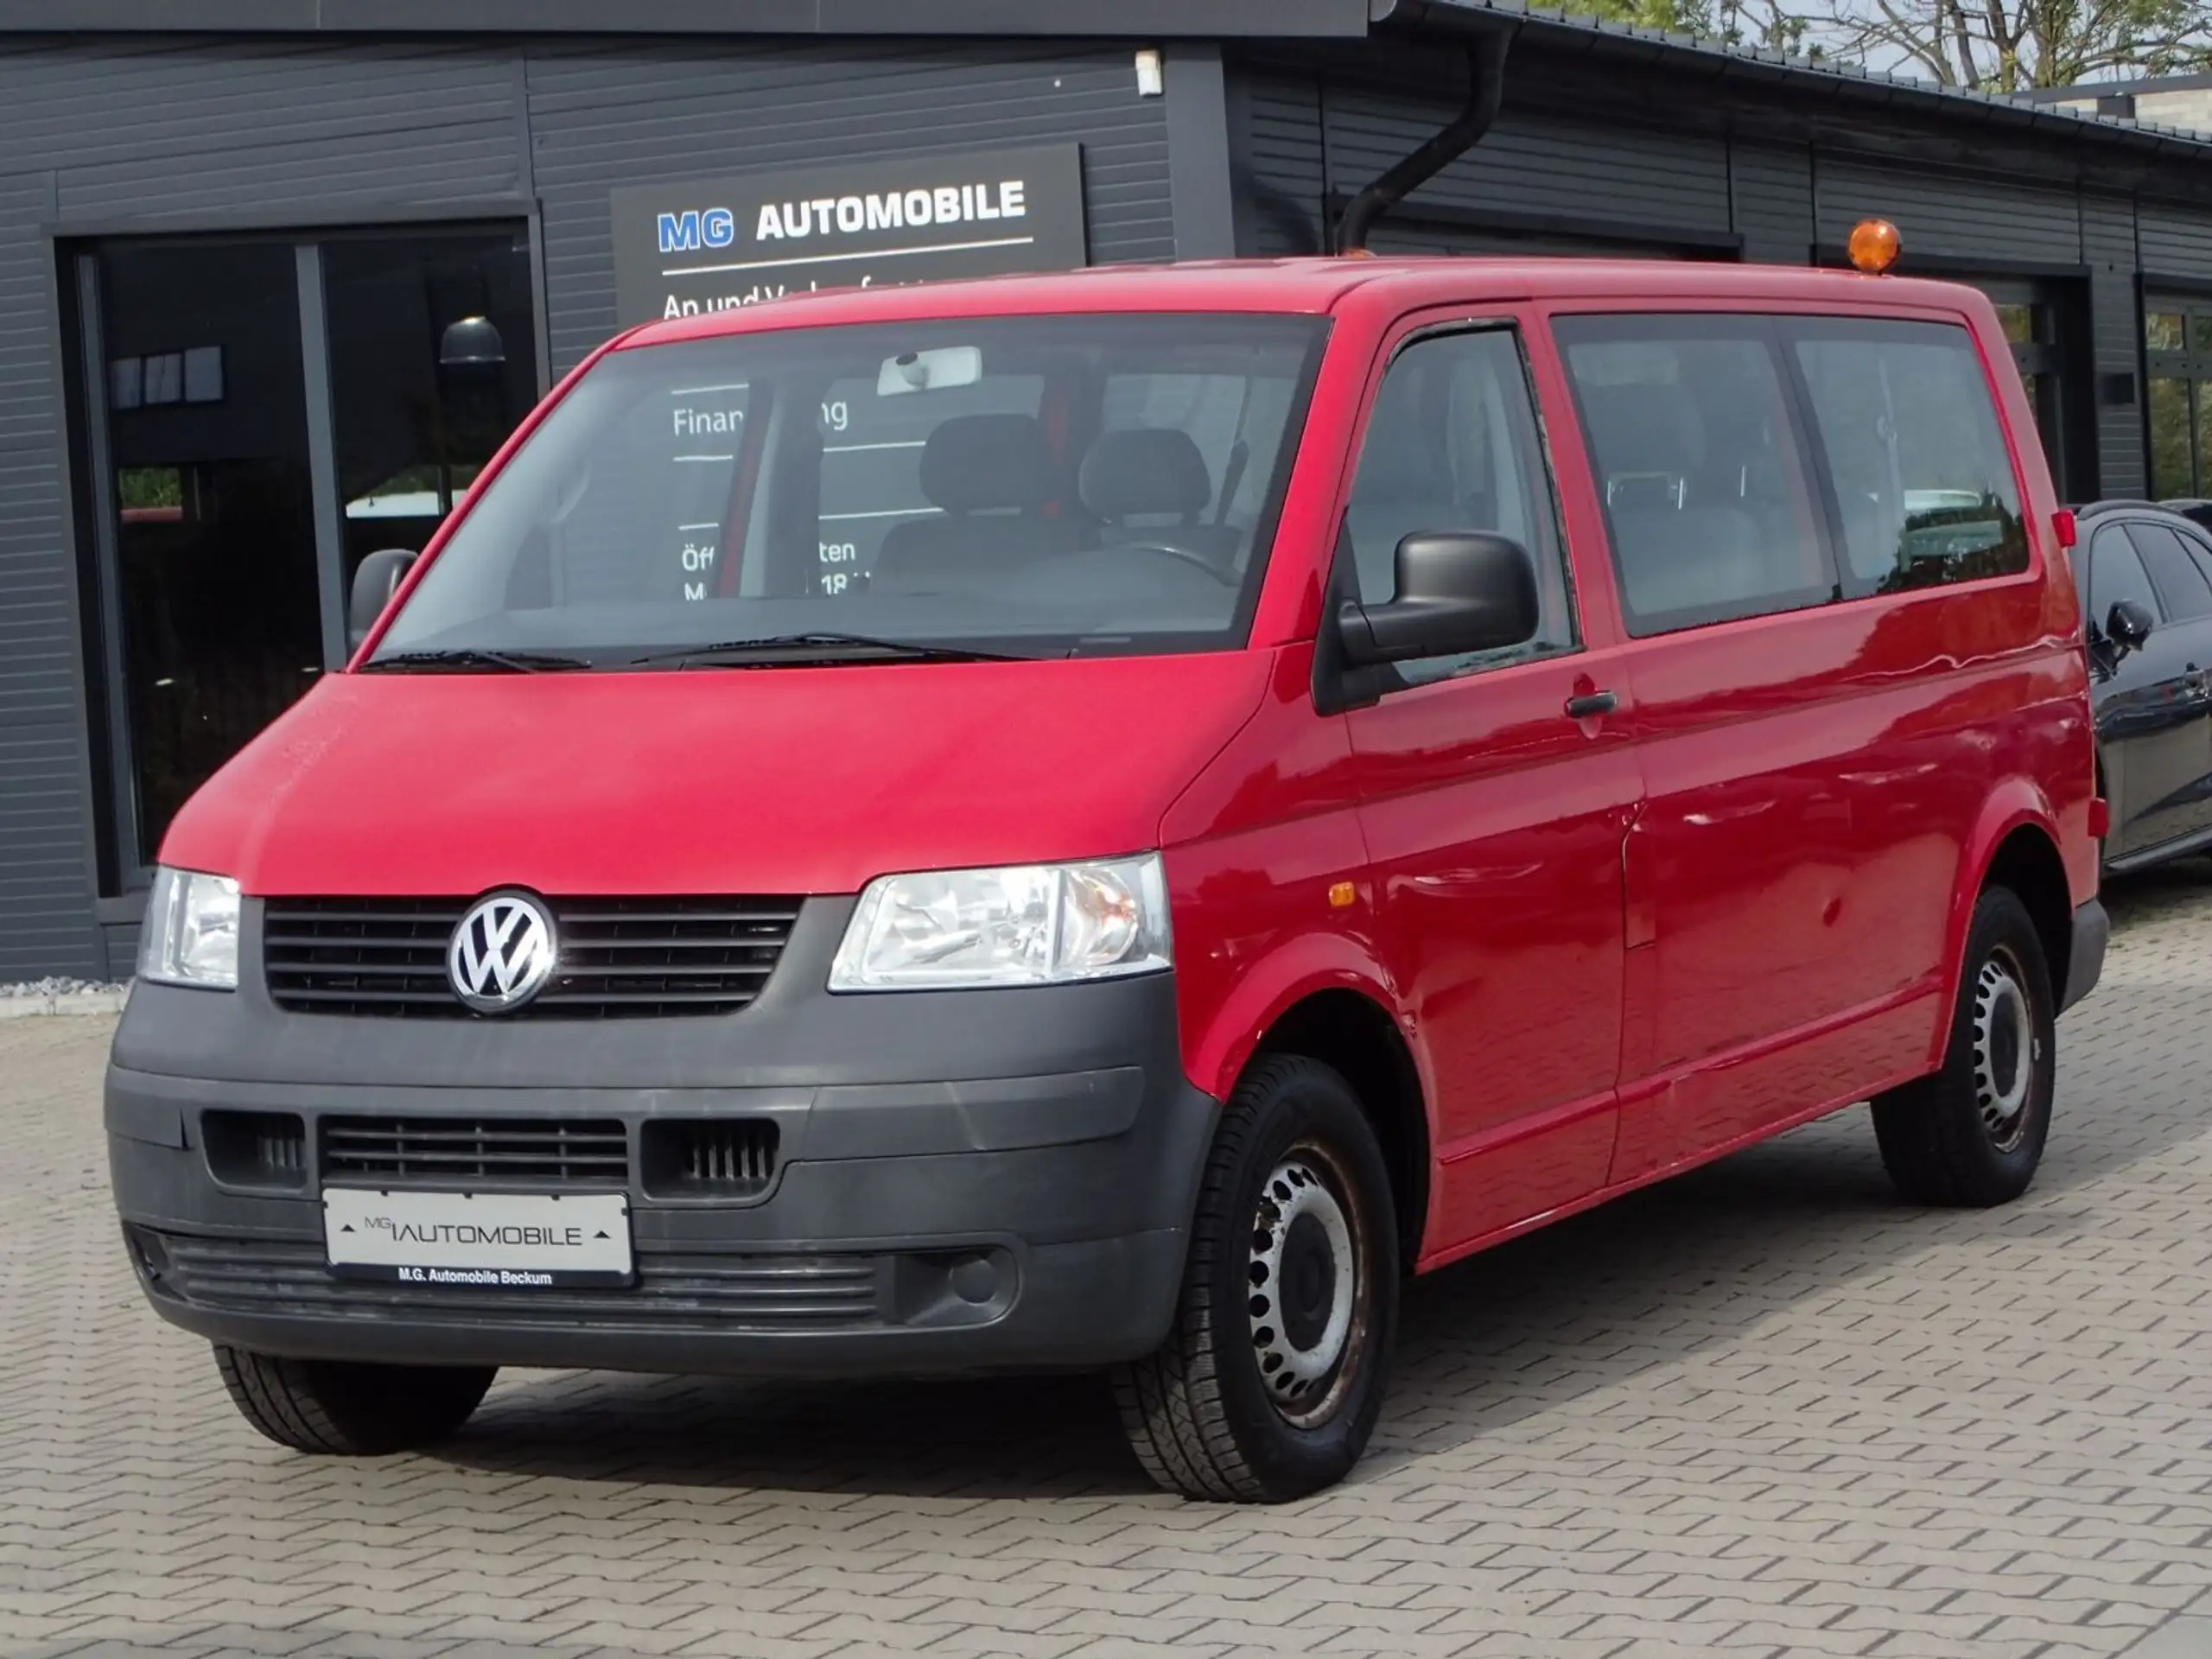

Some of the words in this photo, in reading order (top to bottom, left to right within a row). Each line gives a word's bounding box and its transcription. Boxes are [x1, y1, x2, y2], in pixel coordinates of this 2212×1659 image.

[658, 207, 734, 252] MG
[756, 181, 1027, 241] AUTOMOBILE
[398, 1267, 427, 1281] M.G.
[429, 1268, 499, 1285] Automobile
[501, 1271, 553, 1286] Beckum
